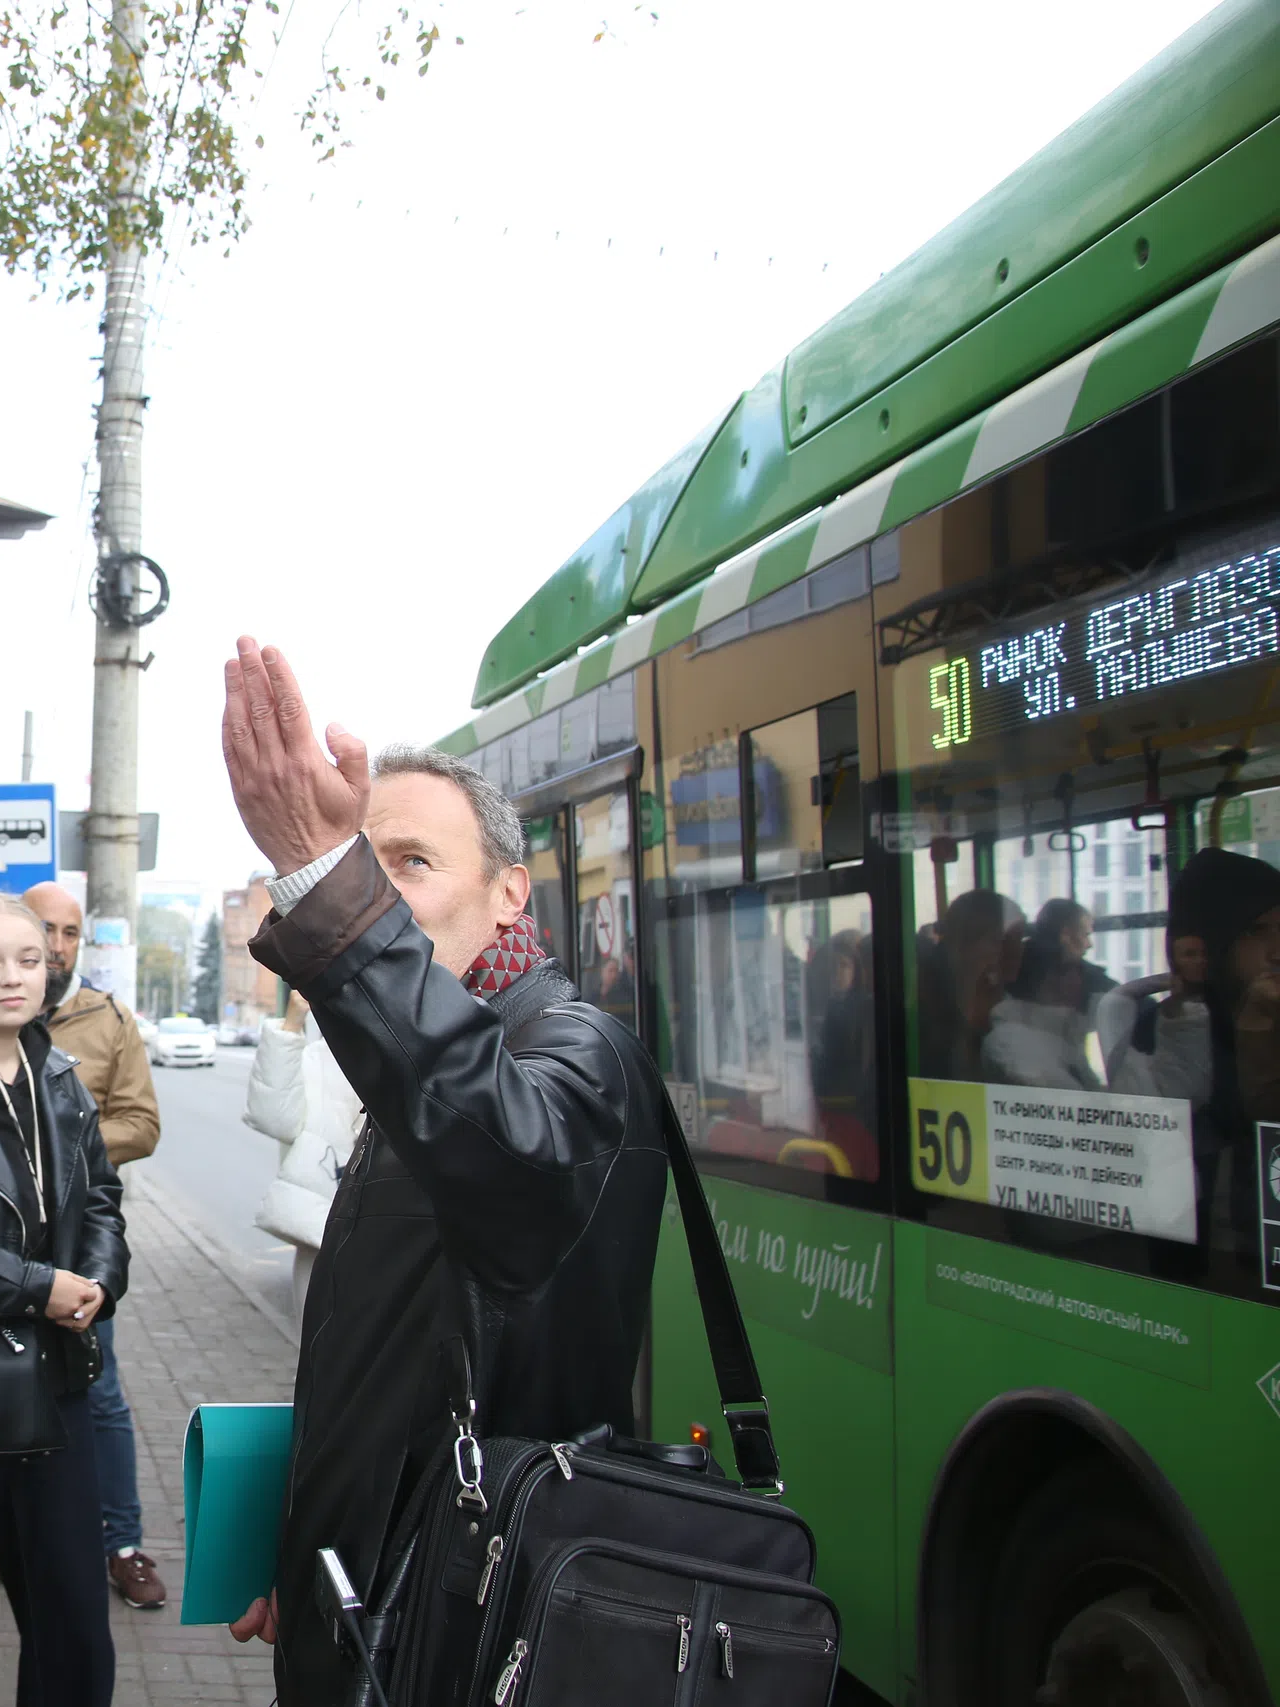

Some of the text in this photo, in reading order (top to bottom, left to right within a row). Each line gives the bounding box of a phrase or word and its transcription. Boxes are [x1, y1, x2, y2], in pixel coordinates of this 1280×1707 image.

[981, 621, 1068, 688] РЫНОК
[1023, 605, 1278, 720] УЛ. МАЛЫШЕВА
[929, 657, 972, 749] 50
[917, 1107, 972, 1187] 50
[993, 1100, 1179, 1132] ТК «РЫНОК НА ДЕРИГЛАЗОВА»
[994, 1129, 1134, 1158] ПР-КТ ПОБЕДЫ МЕГАГРИНН
[995, 1155, 1143, 1189] ЦЕНТР. РЫНОК УЛ. ДЕЙНЕКИ
[995, 1184, 1134, 1231] УЛ. МАЛЫШЕВА
[756, 1228, 787, 1273] по
[793, 1240, 882, 1320] пути!
[935, 1263, 1189, 1345] ООО «ВОЛГОГРАДСКИЙ АВТОБУСНЫЙ ПАРК»
